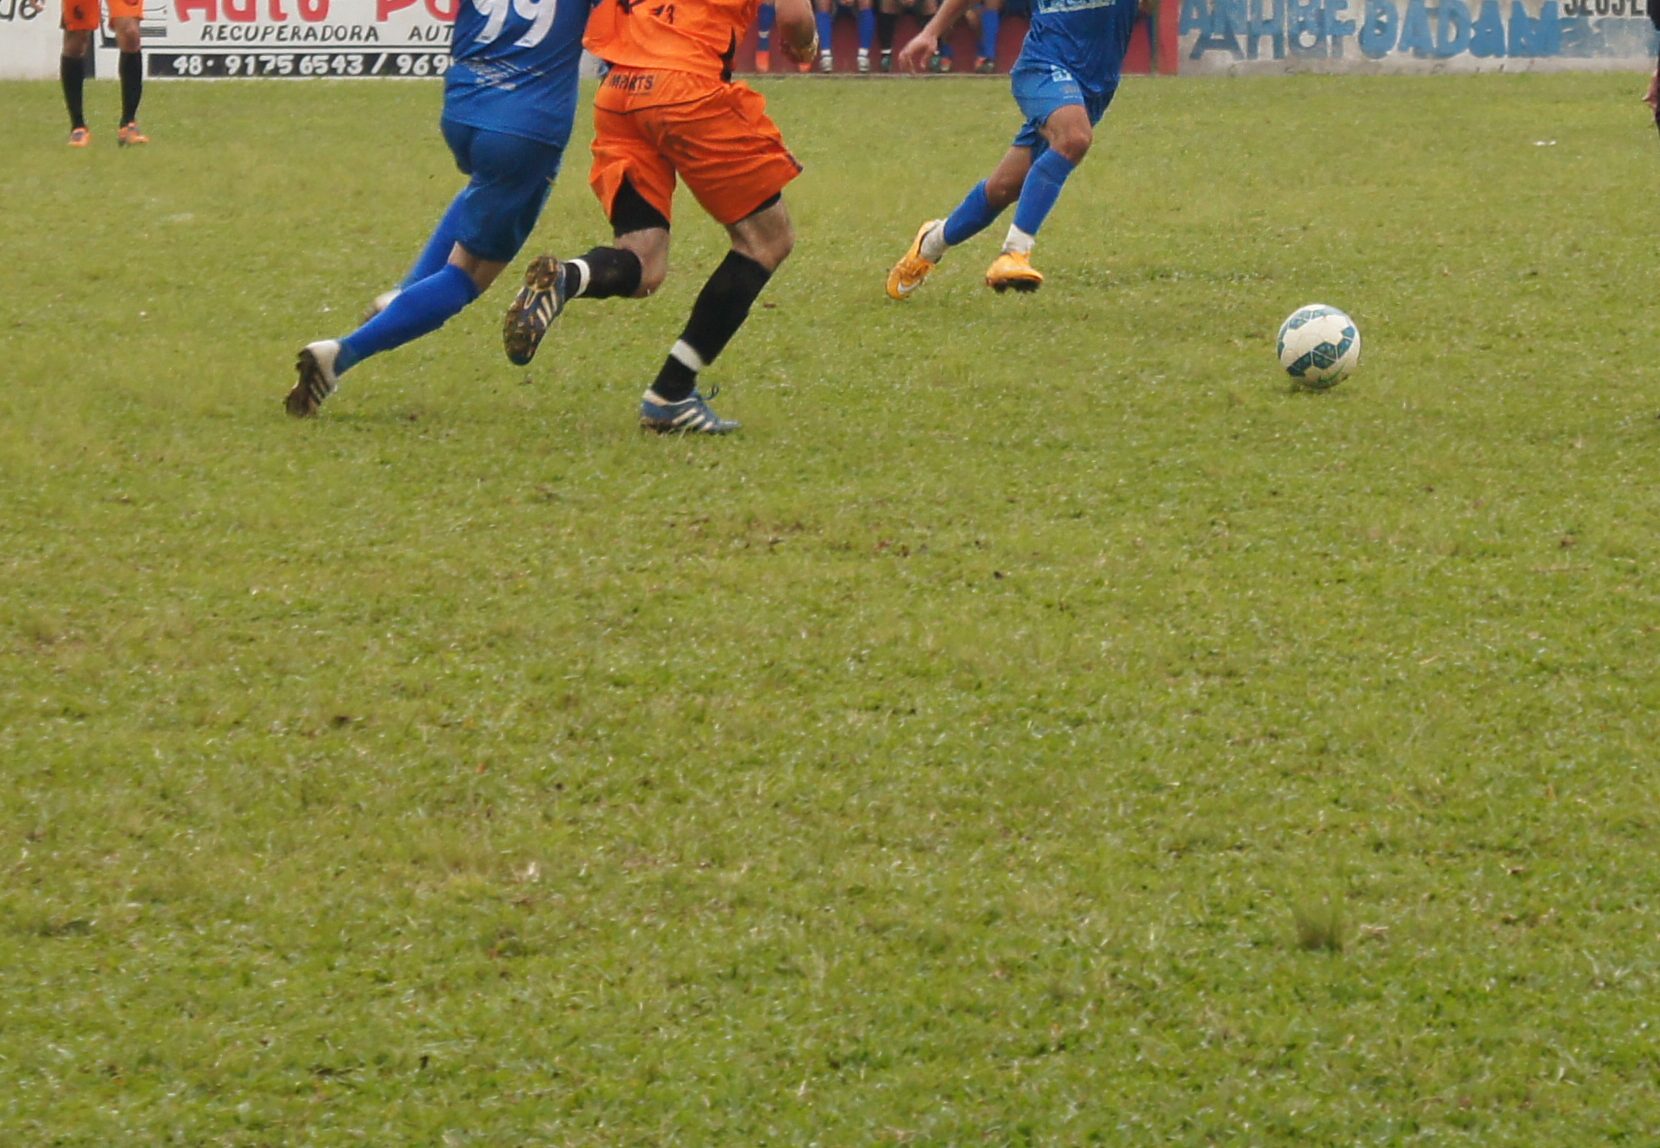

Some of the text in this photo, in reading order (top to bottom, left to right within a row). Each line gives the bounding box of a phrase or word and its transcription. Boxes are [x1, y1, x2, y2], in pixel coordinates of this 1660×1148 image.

[201, 24, 379, 42] RECUPERADORA
[225, 54, 294, 75] 9175
[299, 54, 363, 75] 6543
[397, 54, 454, 75] 969
